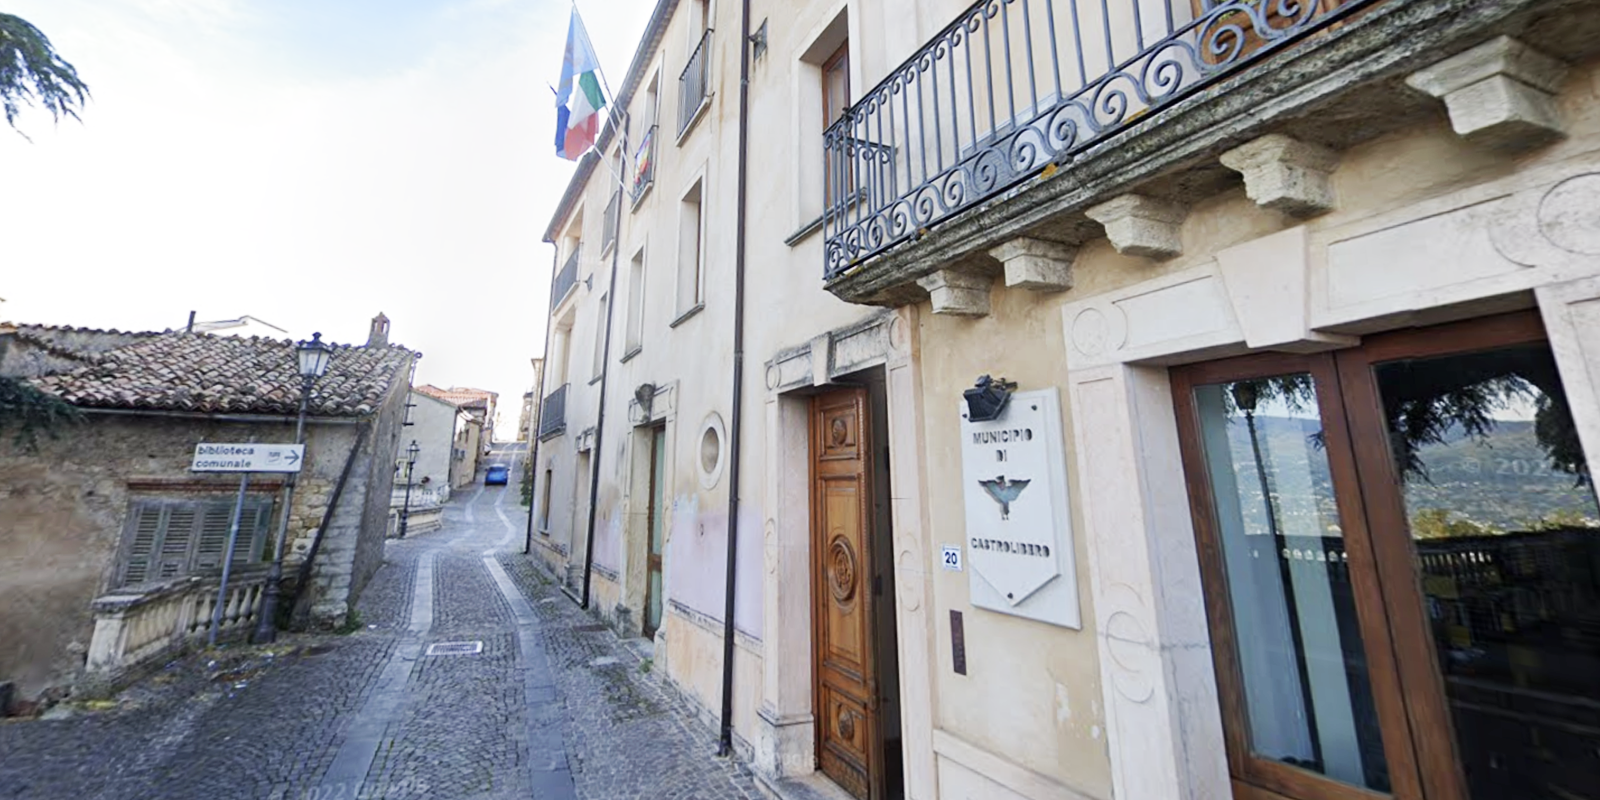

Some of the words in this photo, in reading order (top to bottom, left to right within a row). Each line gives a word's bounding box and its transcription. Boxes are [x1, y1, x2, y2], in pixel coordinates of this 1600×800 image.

[973, 428, 1032, 444] MUNICIPIO
[198, 445, 254, 455] biblioteca
[996, 449, 1007, 462] DI
[195, 459, 252, 468] comunale
[971, 537, 1050, 558] CASTROLIBERO
[944, 551, 958, 565] 20
